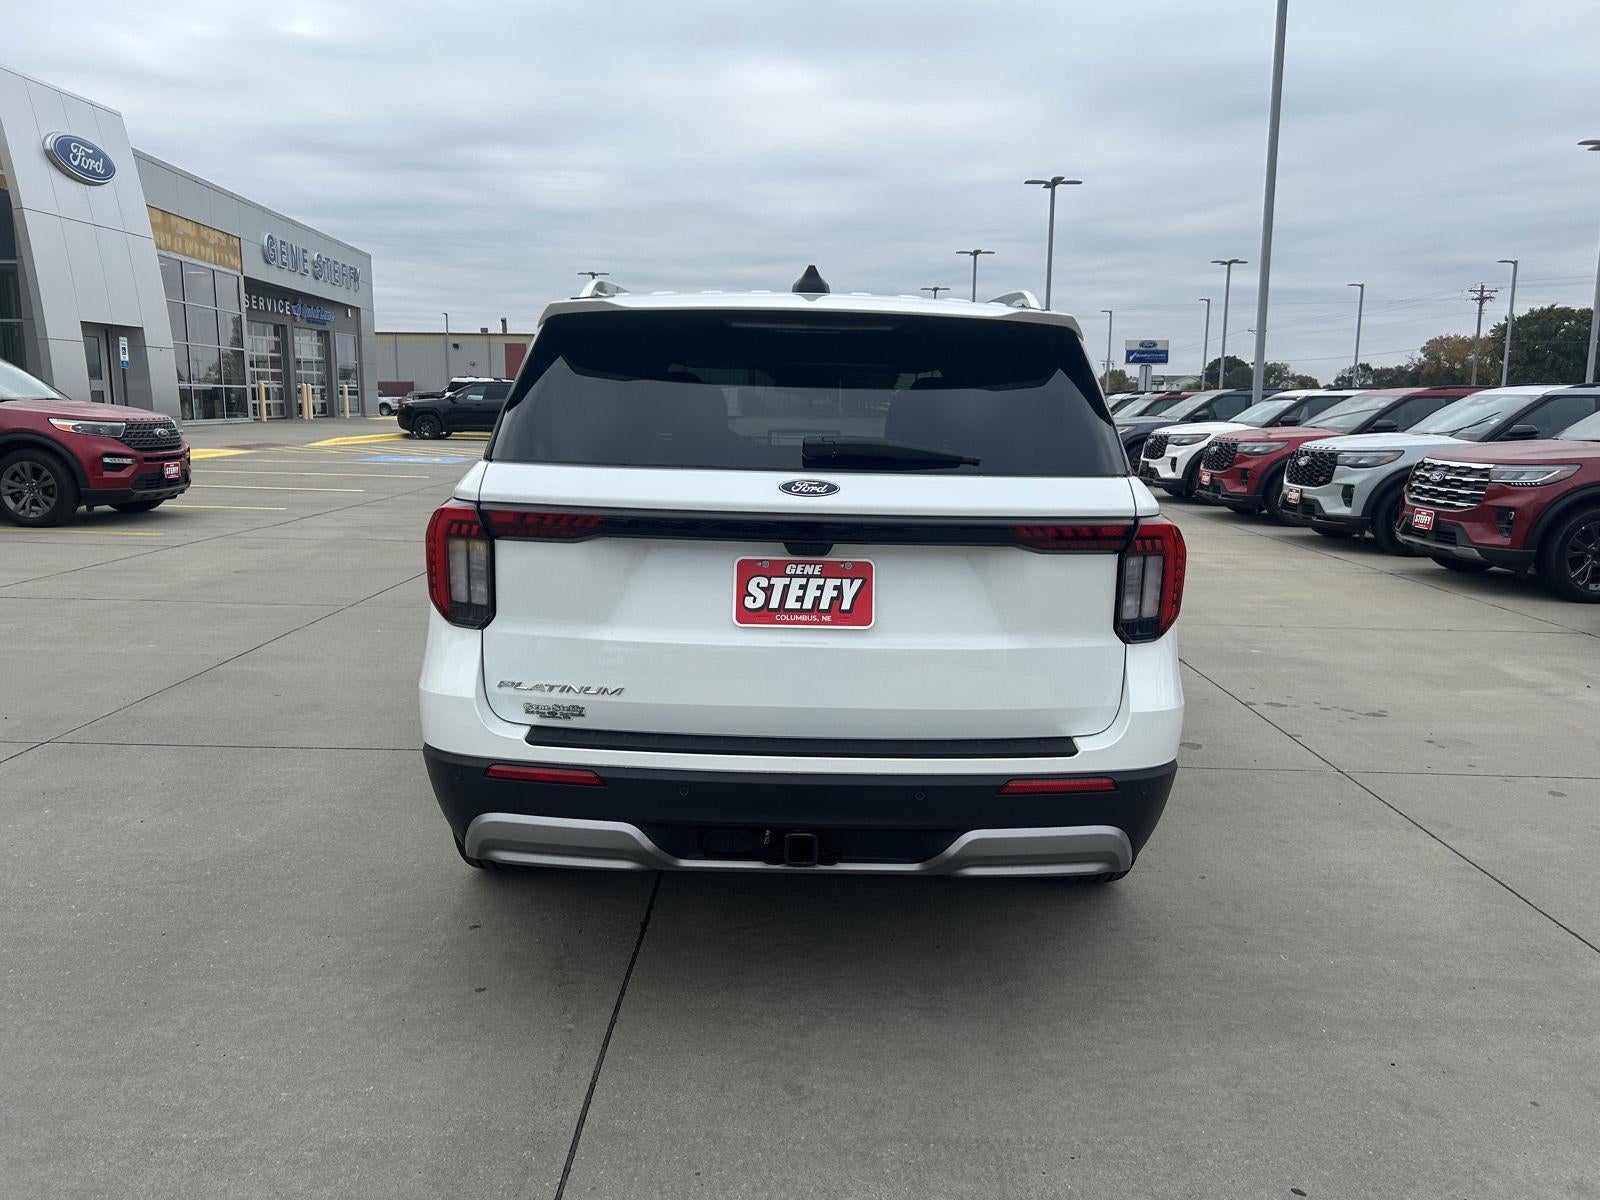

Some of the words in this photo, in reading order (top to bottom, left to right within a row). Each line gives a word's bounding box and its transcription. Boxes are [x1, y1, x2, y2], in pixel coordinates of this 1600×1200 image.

[69, 142, 106, 175] Ford
[263, 232, 310, 276] GENE
[312, 251, 361, 293] STEFFY
[244, 294, 291, 316] SERVICE
[791, 480, 828, 493] Ford
[785, 563, 823, 575] GENE
[743, 575, 866, 613] STEFFY
[775, 614, 819, 623] COLUMBUS,
[497, 680, 625, 696] PLATINUM
